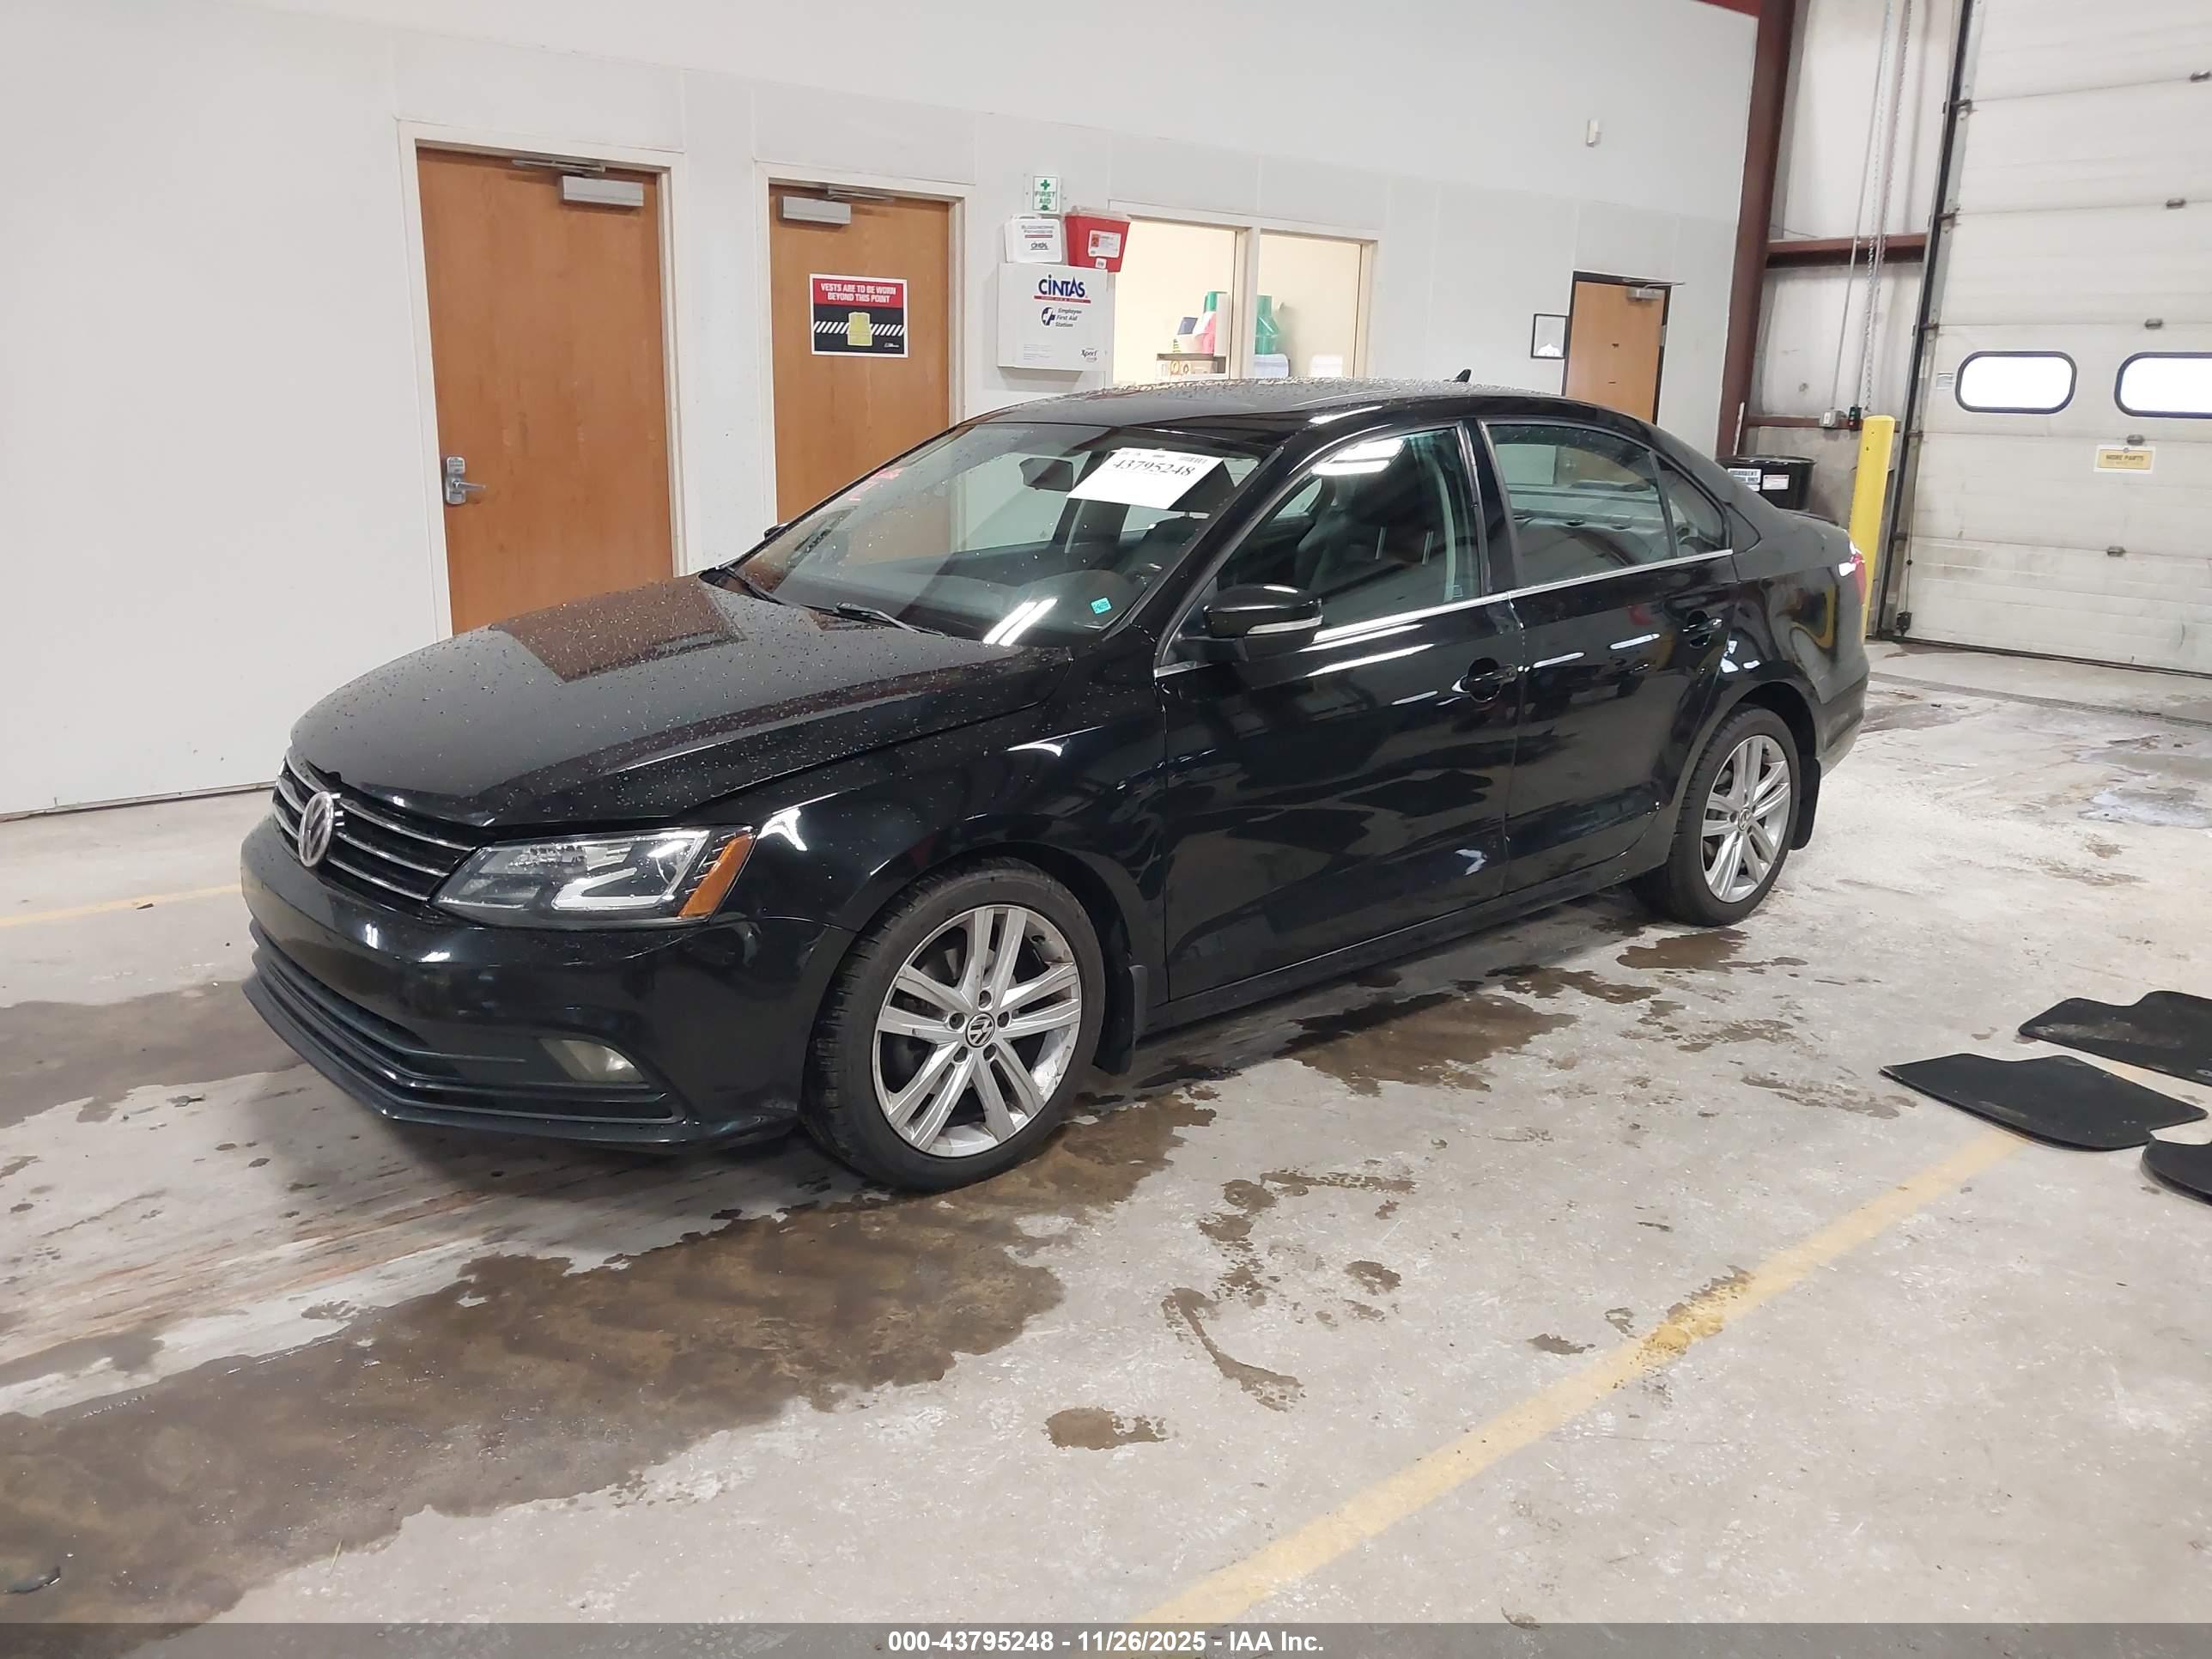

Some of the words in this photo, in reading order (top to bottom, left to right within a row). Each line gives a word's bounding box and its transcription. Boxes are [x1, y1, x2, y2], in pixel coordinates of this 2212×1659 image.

[876, 286, 896, 295] WORN
[1038, 274, 1085, 297] CINTAS
[871, 295, 890, 303] POINT
[1113, 459, 1195, 476] 43795248
